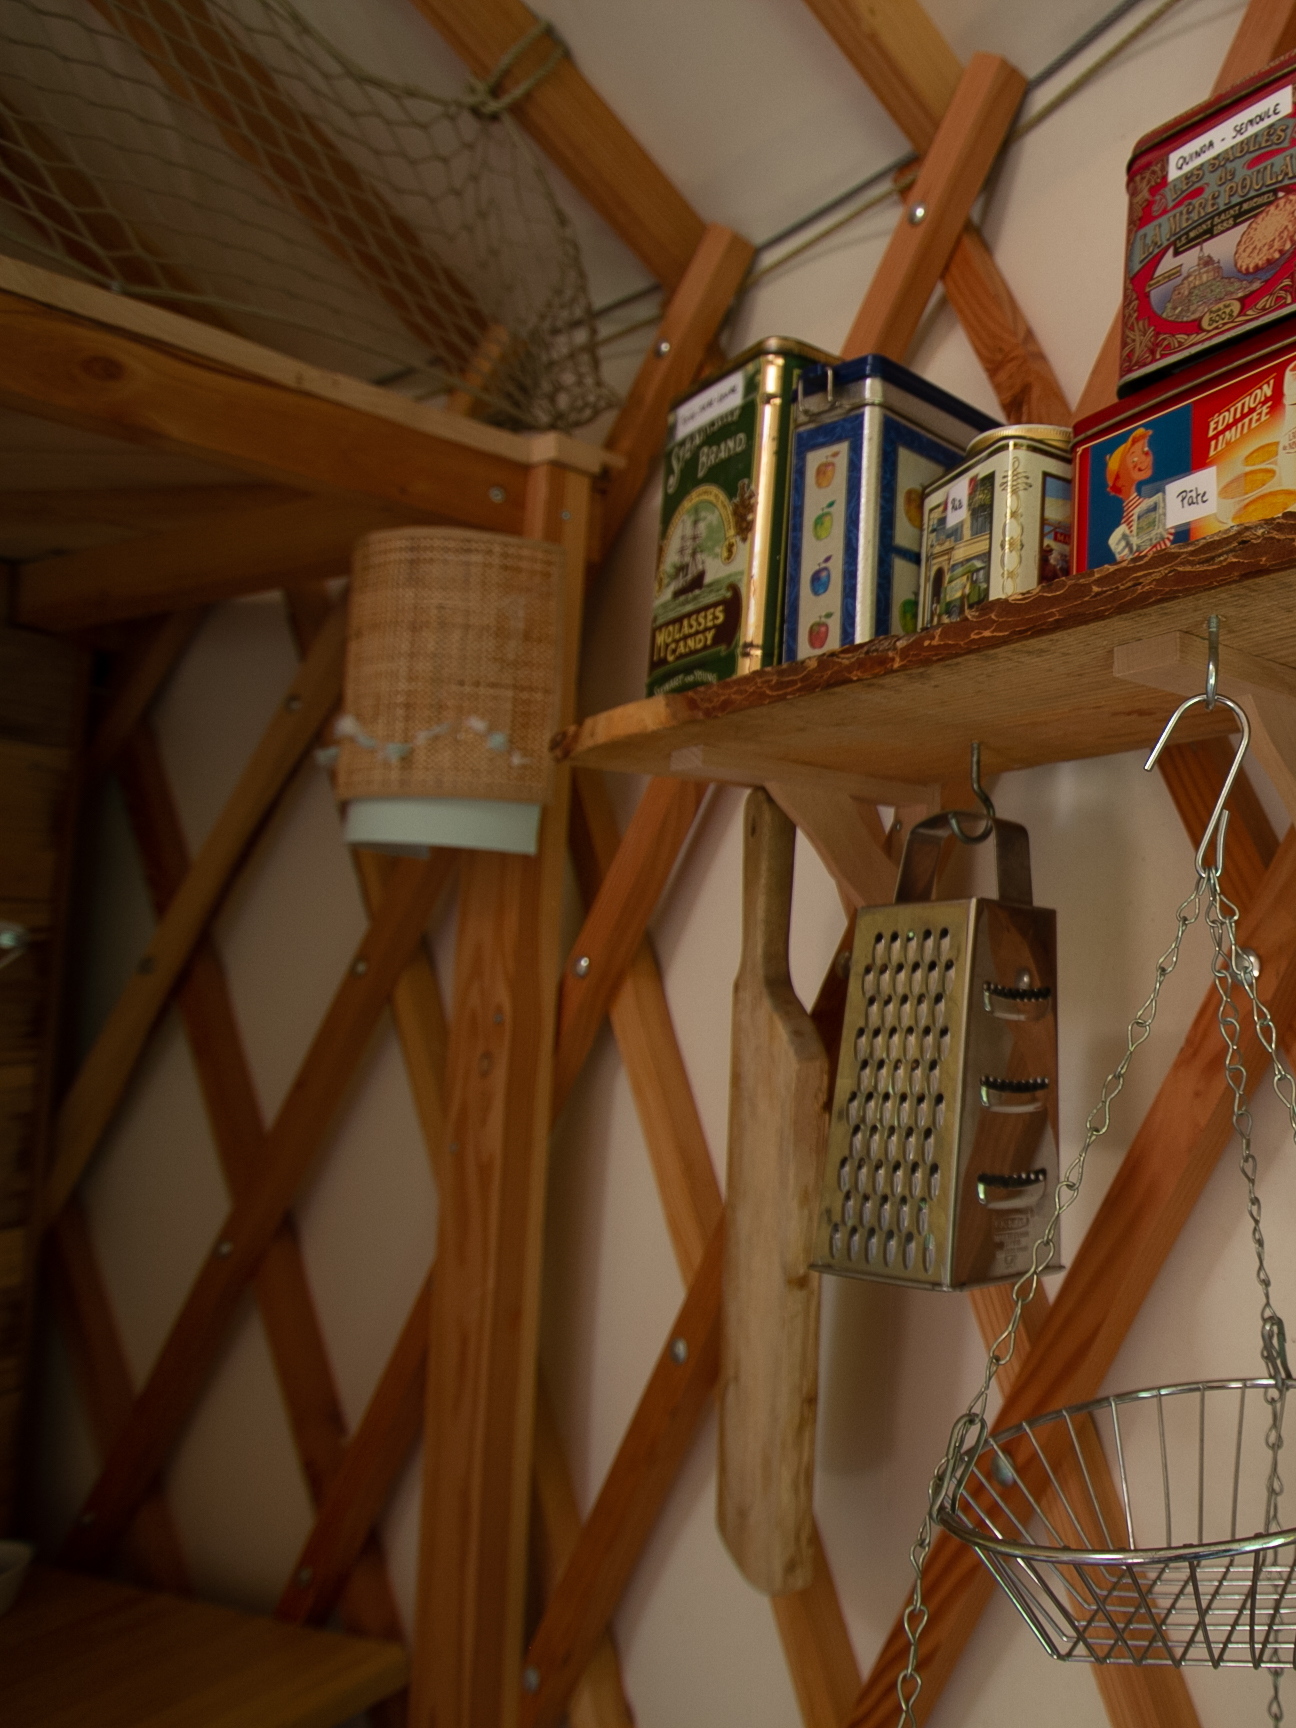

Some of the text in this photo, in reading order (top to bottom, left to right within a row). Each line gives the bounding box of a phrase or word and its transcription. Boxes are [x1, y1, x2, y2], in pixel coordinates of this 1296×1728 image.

[1232, 102, 1281, 139] SEMOULE
[1218, 167, 1235, 185] de
[1139, 222, 1166, 262] LA
[1208, 377, 1275, 439] ÉDITION
[1208, 400, 1274, 459] LIMITÉE
[697, 432, 748, 480] BRAND
[1176, 486, 1209, 509] Pâte
[653, 604, 726, 663] MOLASSES
[666, 627, 717, 663] CANDY
